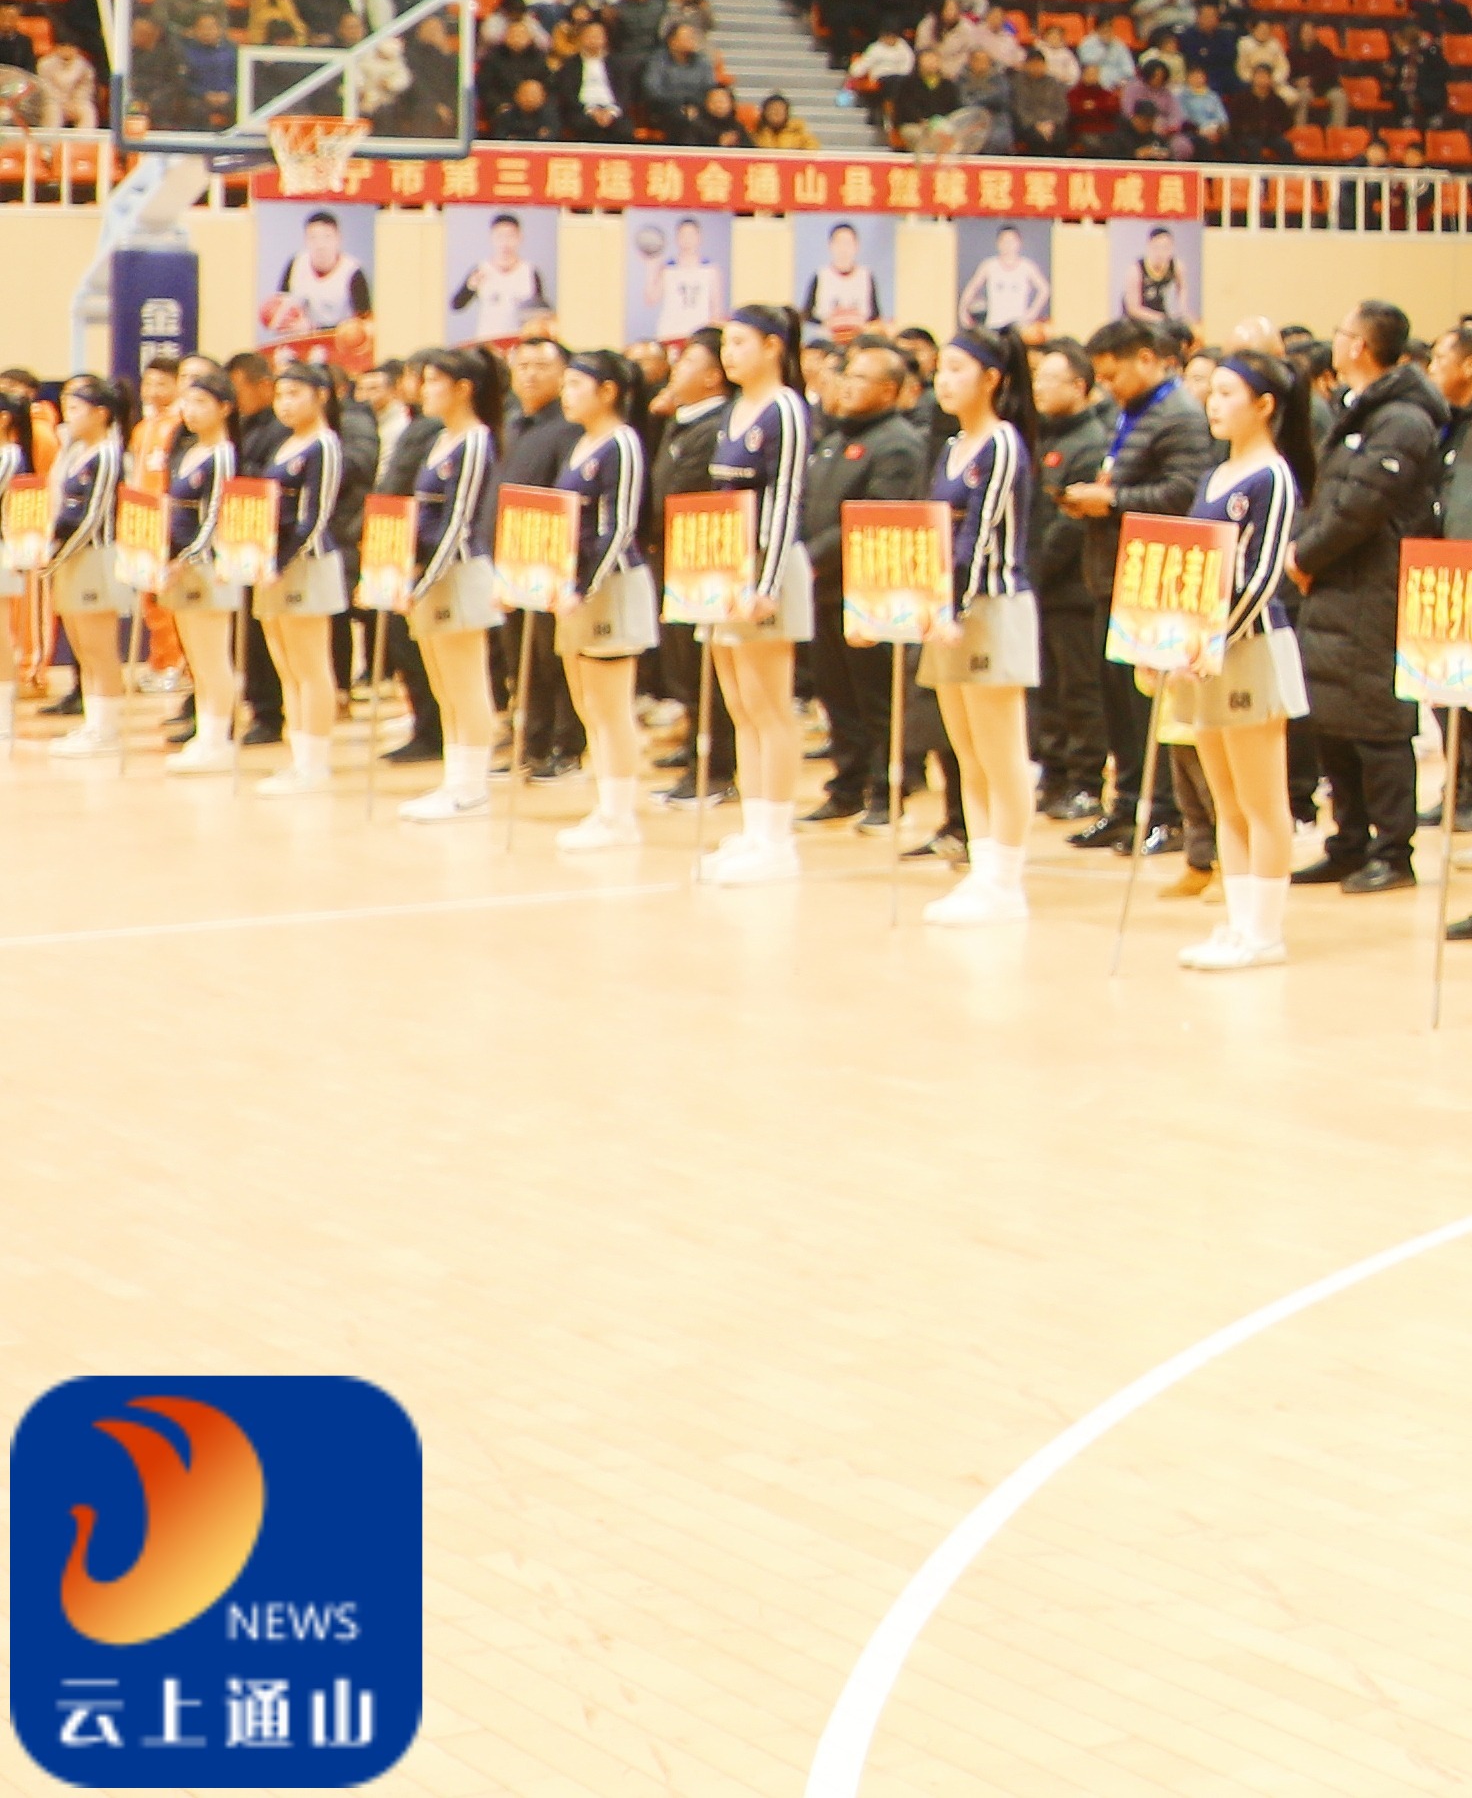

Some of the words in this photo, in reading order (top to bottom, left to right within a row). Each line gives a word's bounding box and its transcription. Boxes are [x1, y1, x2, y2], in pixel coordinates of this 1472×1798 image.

[280, 155, 1187, 214] 宁市第三届运动会通山县篮球冠军队成员
